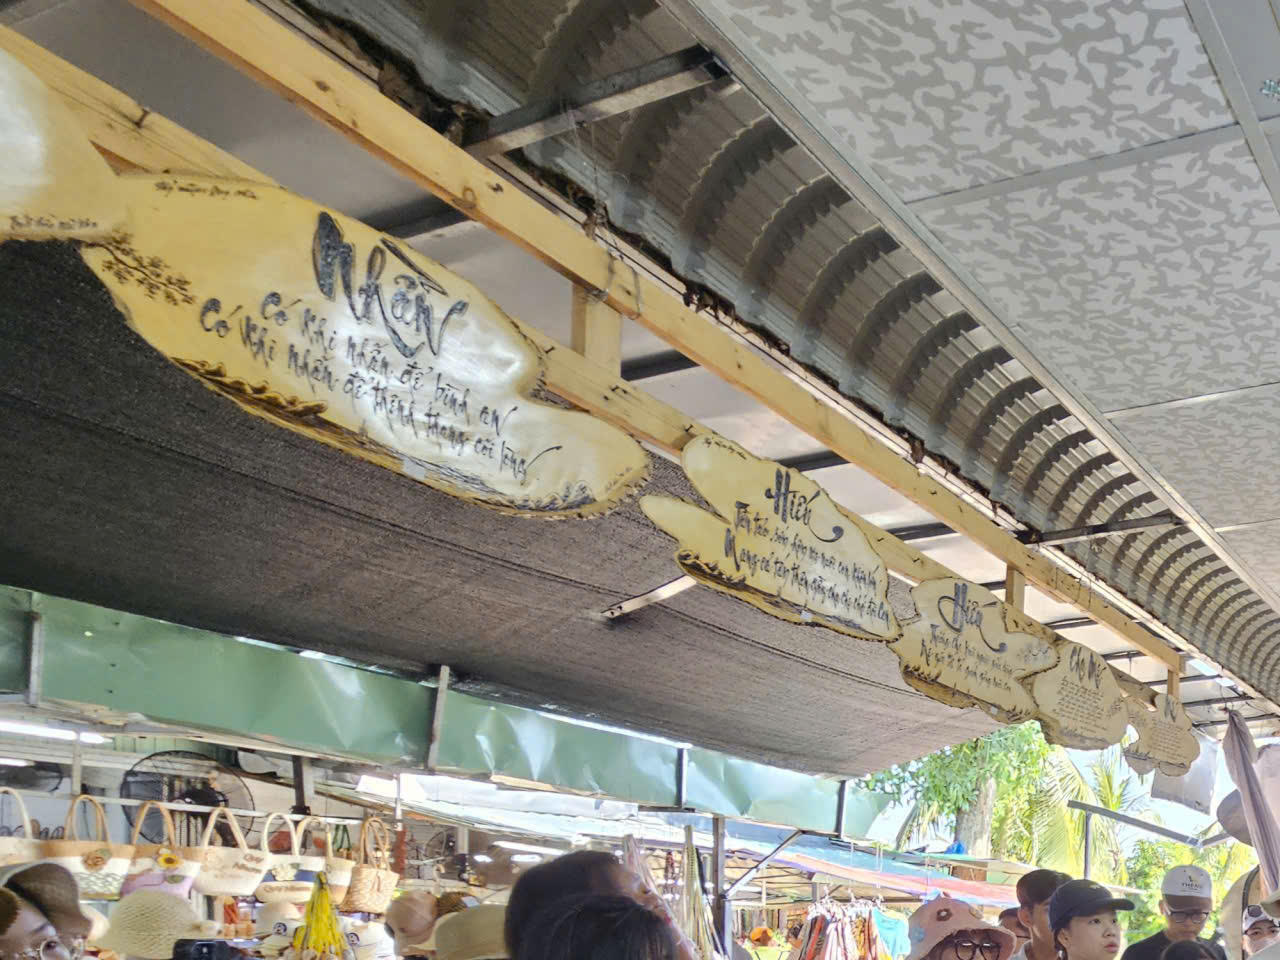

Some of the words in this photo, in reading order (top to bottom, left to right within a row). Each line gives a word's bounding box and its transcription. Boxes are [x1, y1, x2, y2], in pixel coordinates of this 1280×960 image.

[201, 297, 243, 338] Có
[261, 292, 301, 325] Có
[434, 373, 471, 425] bình
